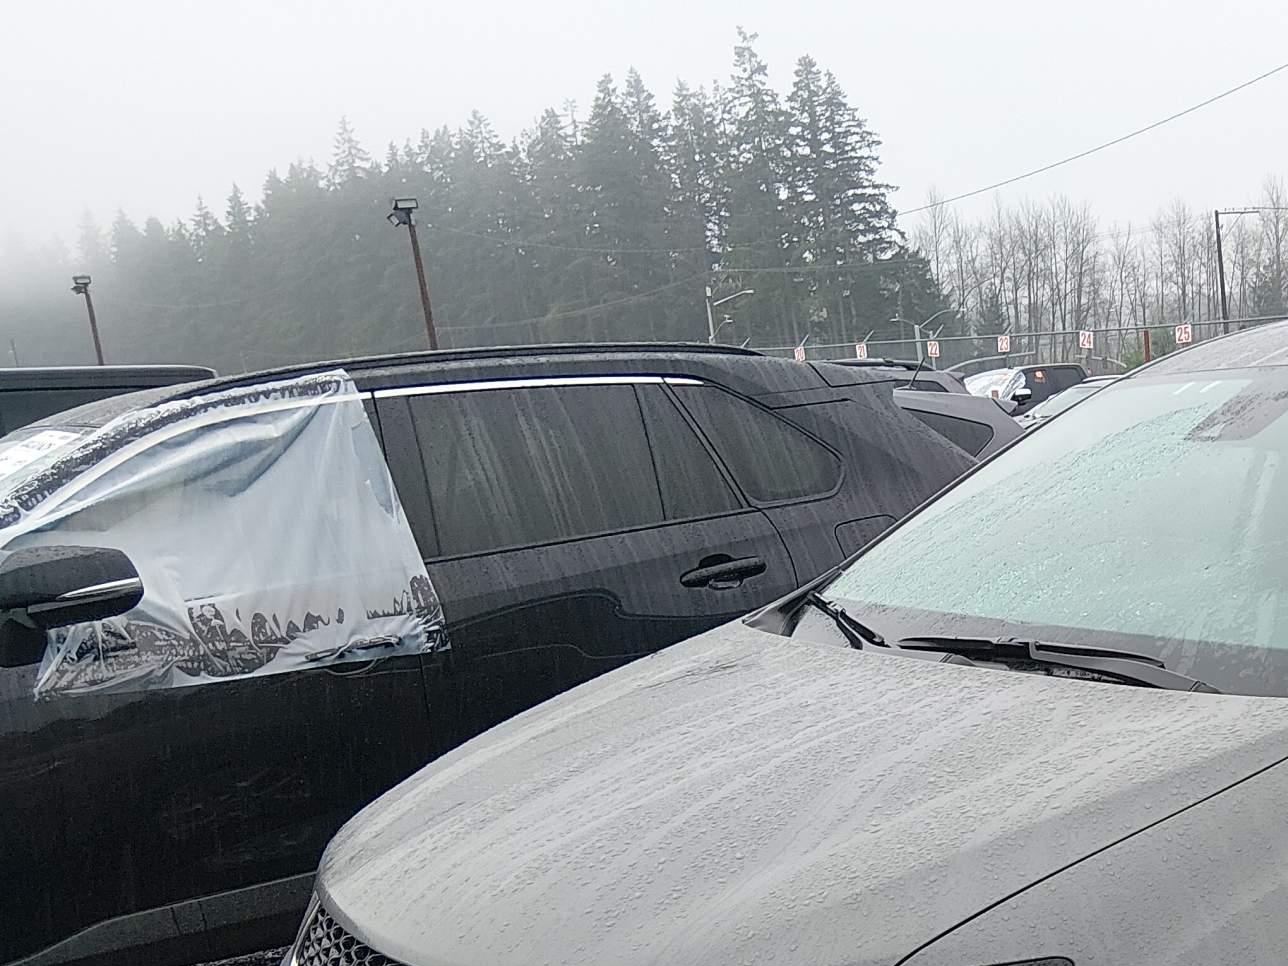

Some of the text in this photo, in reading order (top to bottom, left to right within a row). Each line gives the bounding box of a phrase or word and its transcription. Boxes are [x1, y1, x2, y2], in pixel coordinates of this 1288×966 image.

[1081, 332, 1092, 347] 24
[1177, 325, 1190, 341] 25
[929, 342, 938, 355] 22
[999, 337, 1009, 350] 23
